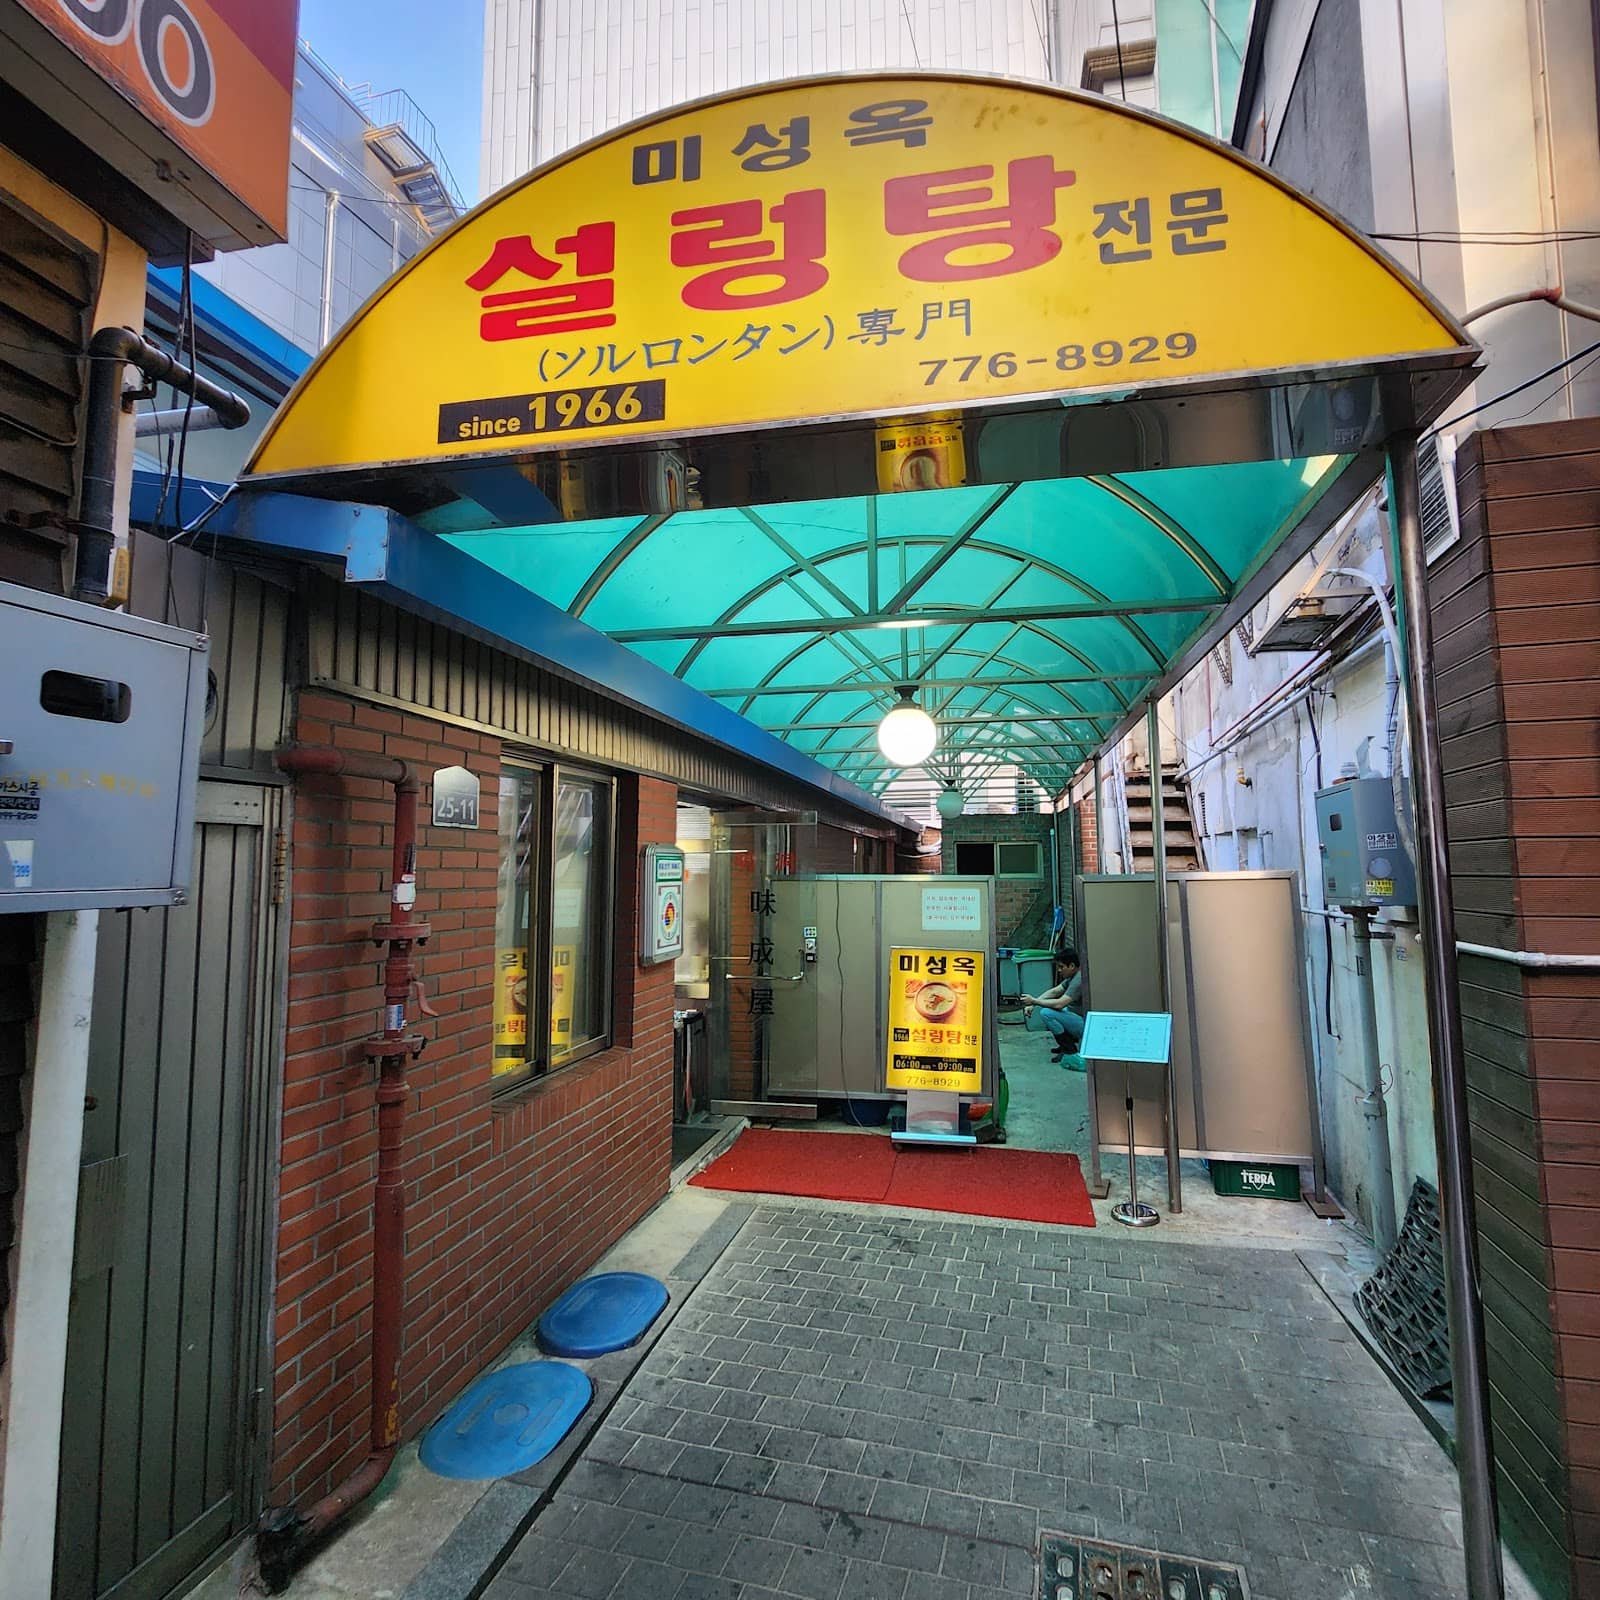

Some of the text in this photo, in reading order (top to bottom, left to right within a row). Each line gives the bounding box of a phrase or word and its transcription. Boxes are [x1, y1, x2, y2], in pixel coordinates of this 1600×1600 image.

[633, 99, 934, 184] 미성옥
[466, 155, 1229, 342] 설렁탕 전문
[918, 331, 1198, 387] 776-8929
[458, 385, 643, 439] since 1966
[437, 796, 474, 820] 25-11
[747, 888, 777, 1016] 味成屋
[899, 955, 976, 977] 미성옥
[895, 1059, 920, 1068] 06:00
[938, 1062, 963, 1071] 09:00
[905, 1076, 960, 1087] 776-8929
[1240, 1169, 1276, 1187] TERRA
